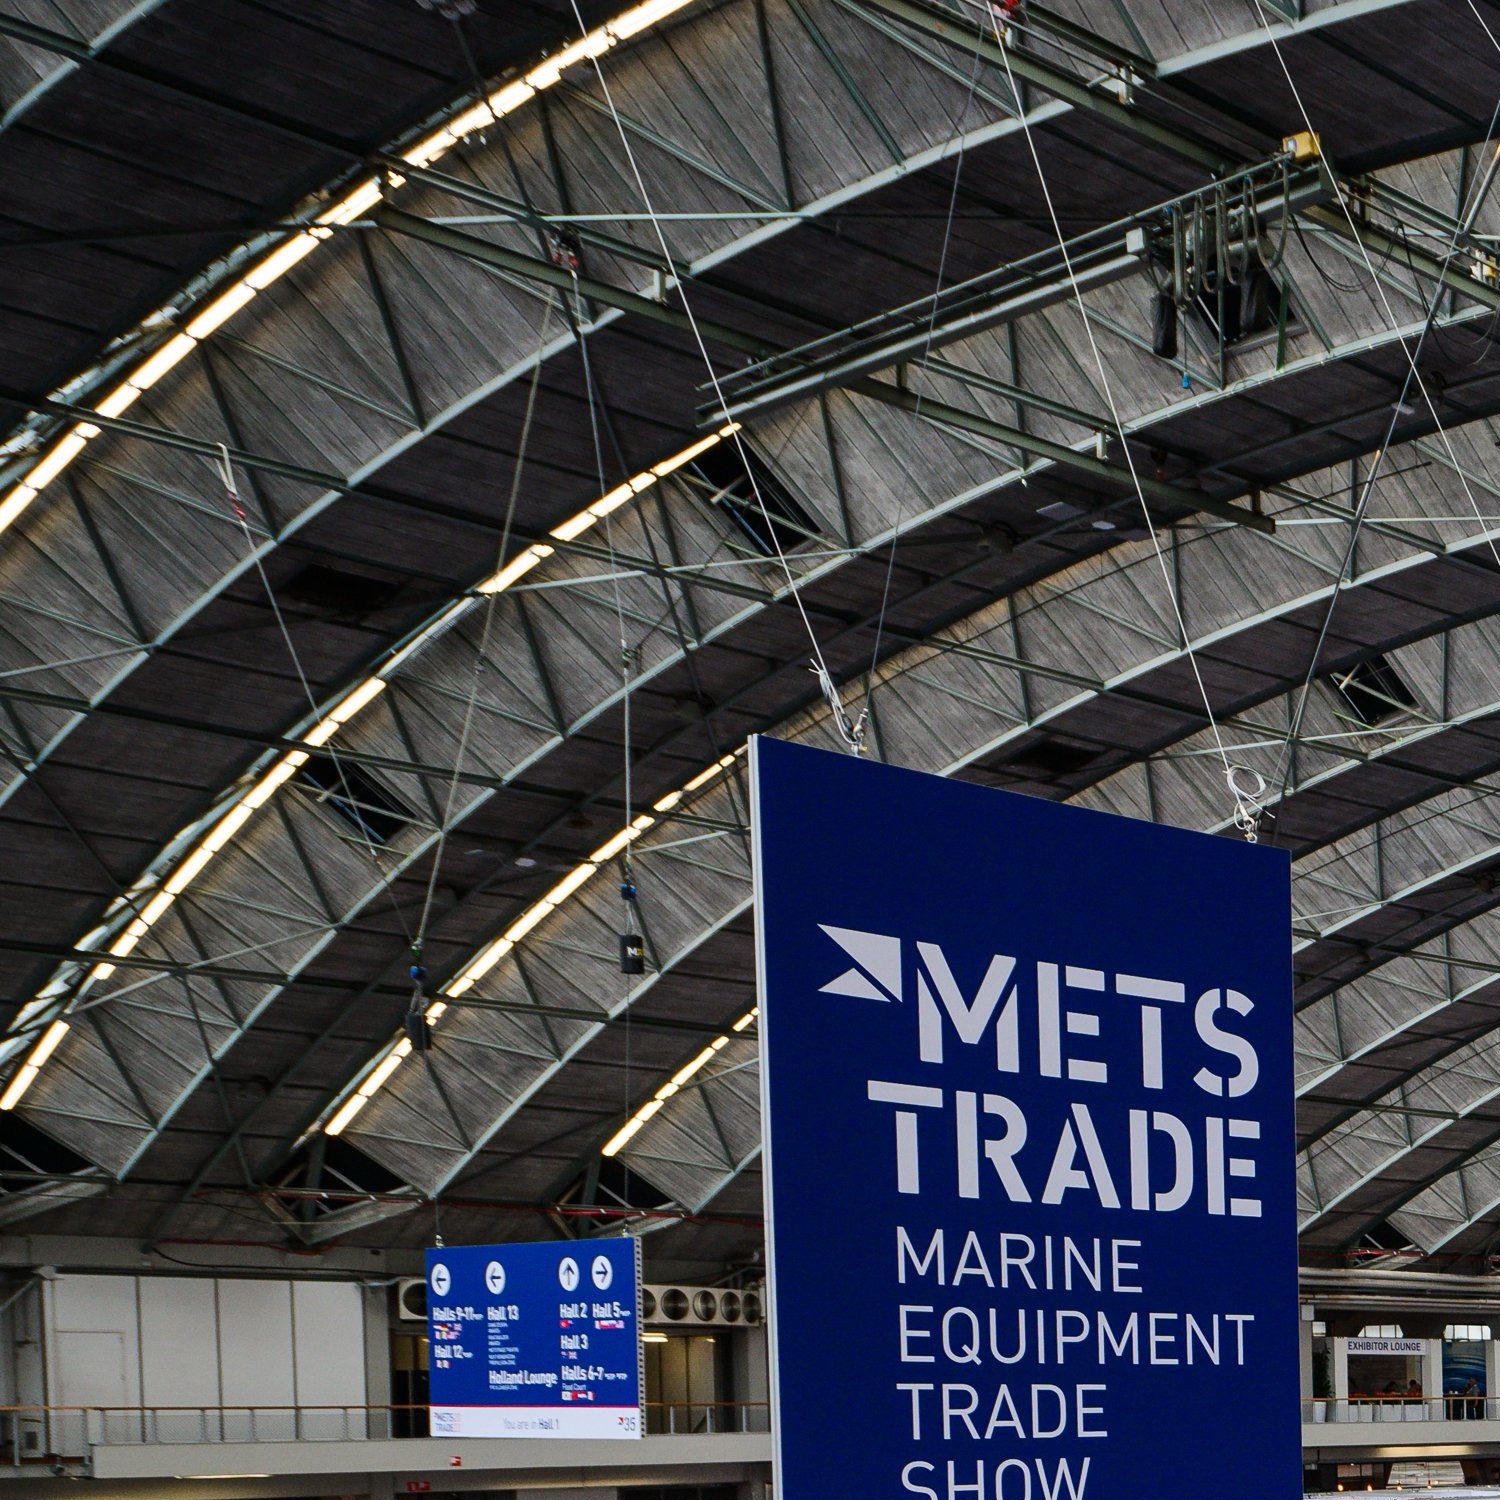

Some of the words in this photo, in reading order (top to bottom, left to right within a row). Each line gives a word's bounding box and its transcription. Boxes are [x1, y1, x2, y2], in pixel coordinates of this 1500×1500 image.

[917, 940, 1259, 1098] METS
[868, 1080, 1261, 1217] TRADE
[897, 1226, 1142, 1292] MARINE
[487, 1306, 506, 1320] Hall
[507, 1305, 519, 1320] 13
[560, 1304, 578, 1318] Hall
[580, 1303, 588, 1318] 2
[592, 1303, 611, 1318] Hall
[612, 1302, 620, 1317] 5
[561, 1335, 579, 1349] Hall
[580, 1334, 589, 1349] 3
[900, 1304, 1254, 1366] EQUIPMENT
[1348, 1341, 1388, 1351] EXHIBITOR
[1390, 1342, 1421, 1352] LOUNGE
[489, 1370, 523, 1385] Holland
[524, 1372, 558, 1387] Lounge
[896, 1383, 1107, 1440] TRADE
[624, 1417, 636, 1431] 35
